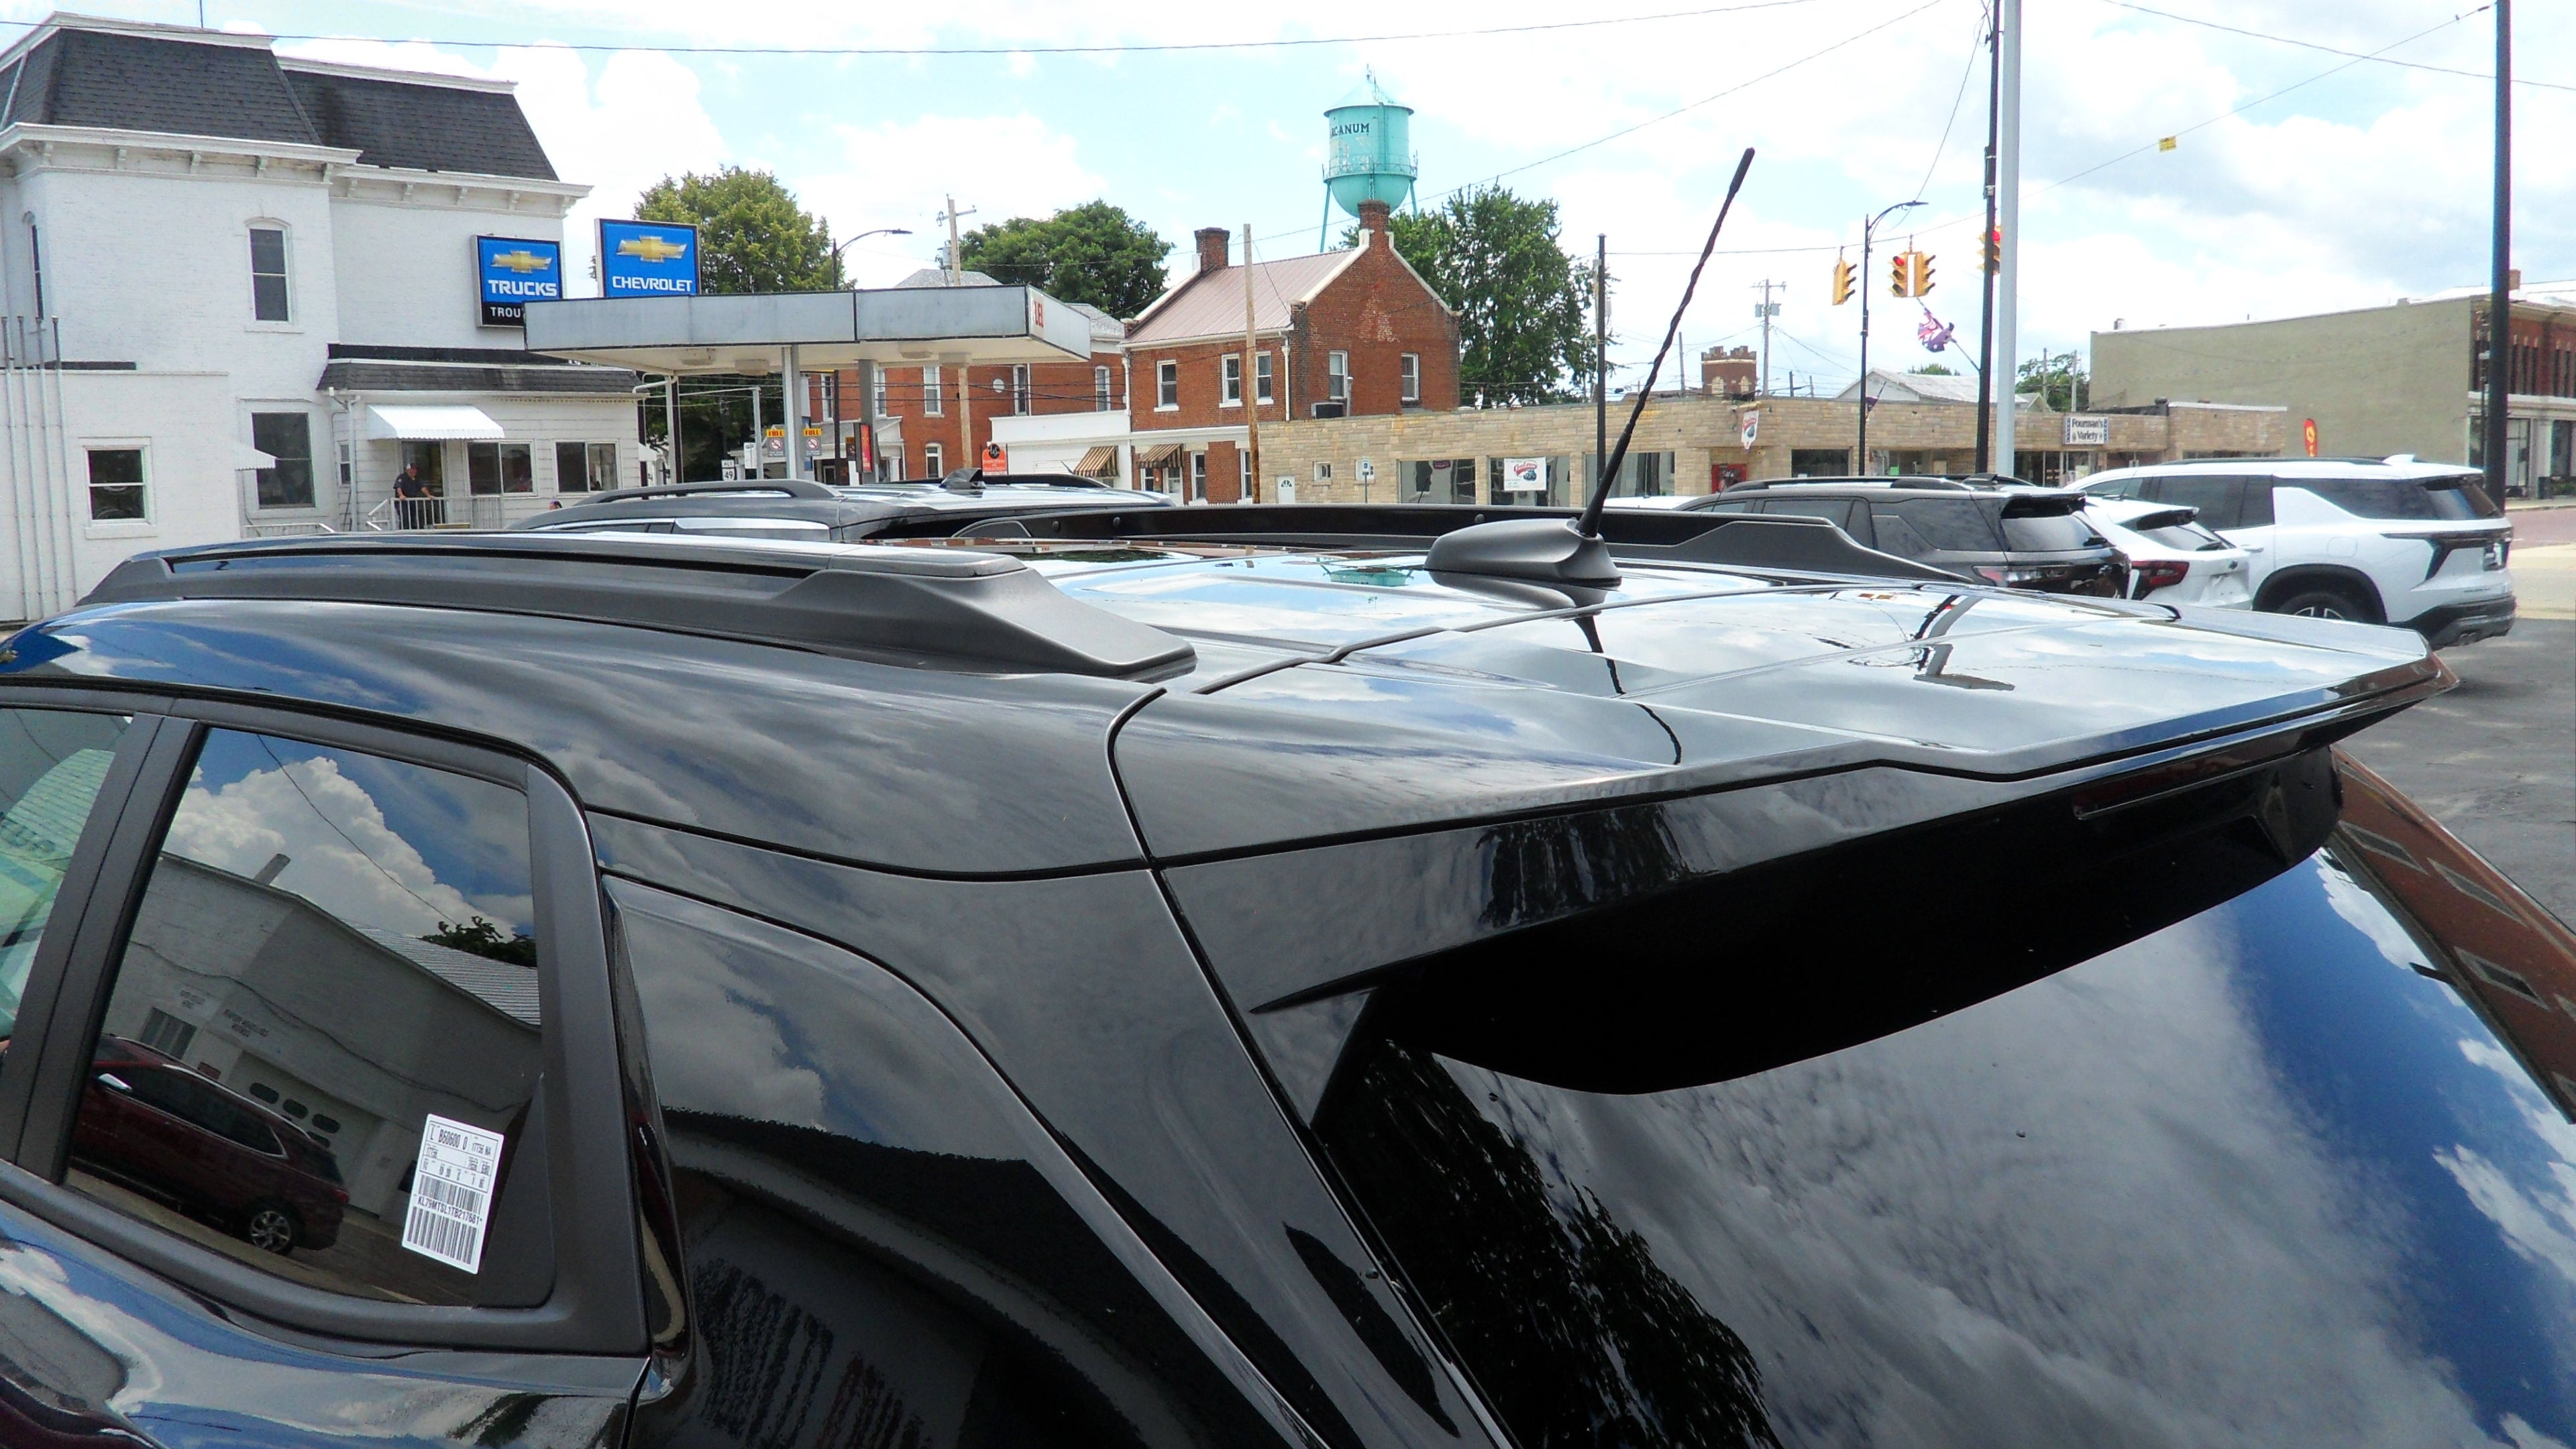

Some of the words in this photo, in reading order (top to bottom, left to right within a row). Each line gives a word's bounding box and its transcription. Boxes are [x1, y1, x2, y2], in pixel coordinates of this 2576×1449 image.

[488, 280, 557, 297] TRUCKS
[612, 276, 692, 292] CHEVROLET
[490, 307, 525, 318] TROU
[2072, 419, 2104, 428] Fourman's
[2077, 431, 2098, 442] Variety
[724, 471, 733, 480] 49
